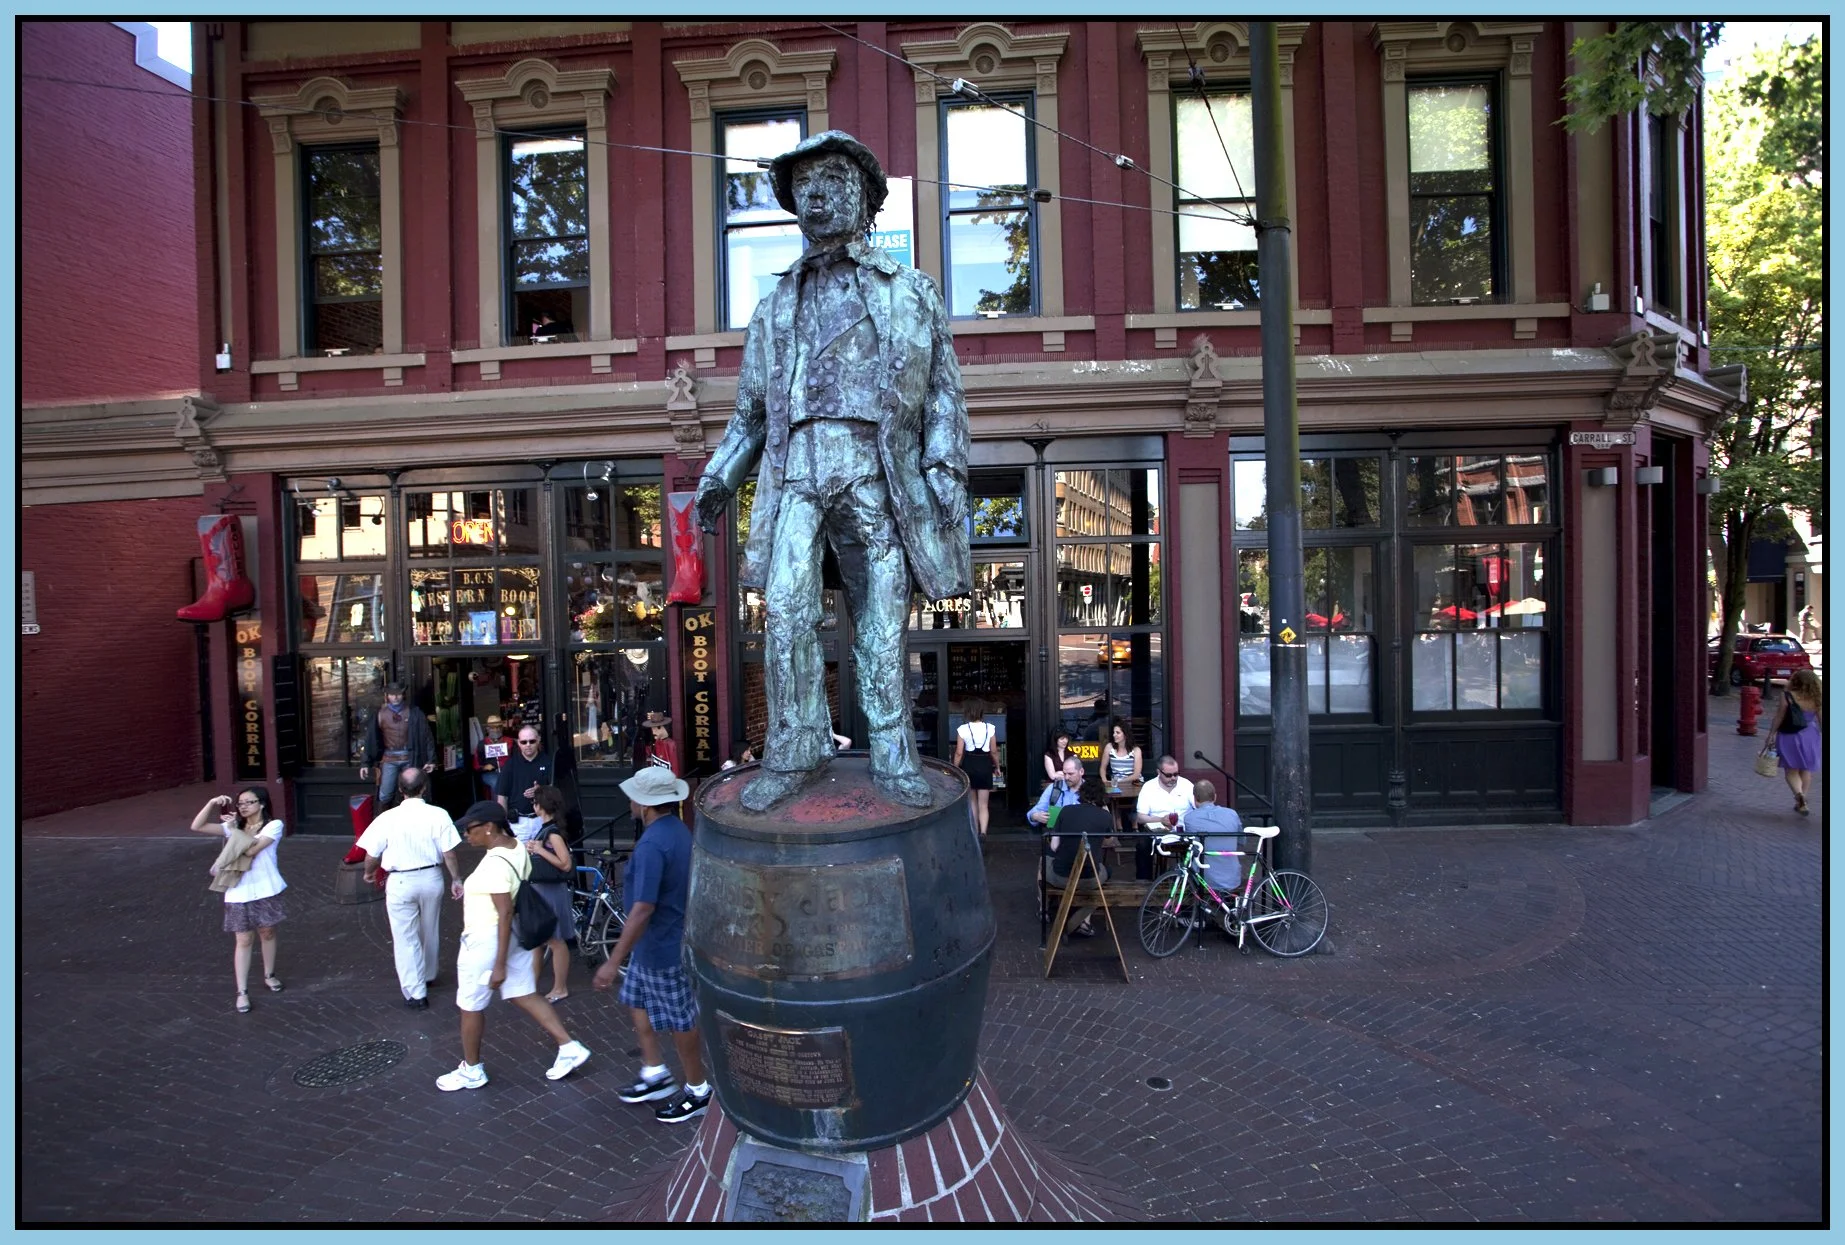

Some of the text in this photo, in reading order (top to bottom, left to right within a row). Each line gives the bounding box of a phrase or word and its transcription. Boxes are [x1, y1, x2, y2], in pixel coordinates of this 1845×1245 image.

[1573, 433, 1611, 443] CARRALL
[452, 520, 494, 544] OPEN
[500, 589, 537, 605] BOOT
[923, 597, 972, 613] ACRES
[685, 612, 714, 761] OK BOOT CORRAL
[236, 626, 262, 766] OK BOOT CORRAL
[1068, 745, 1099, 758] PEN
